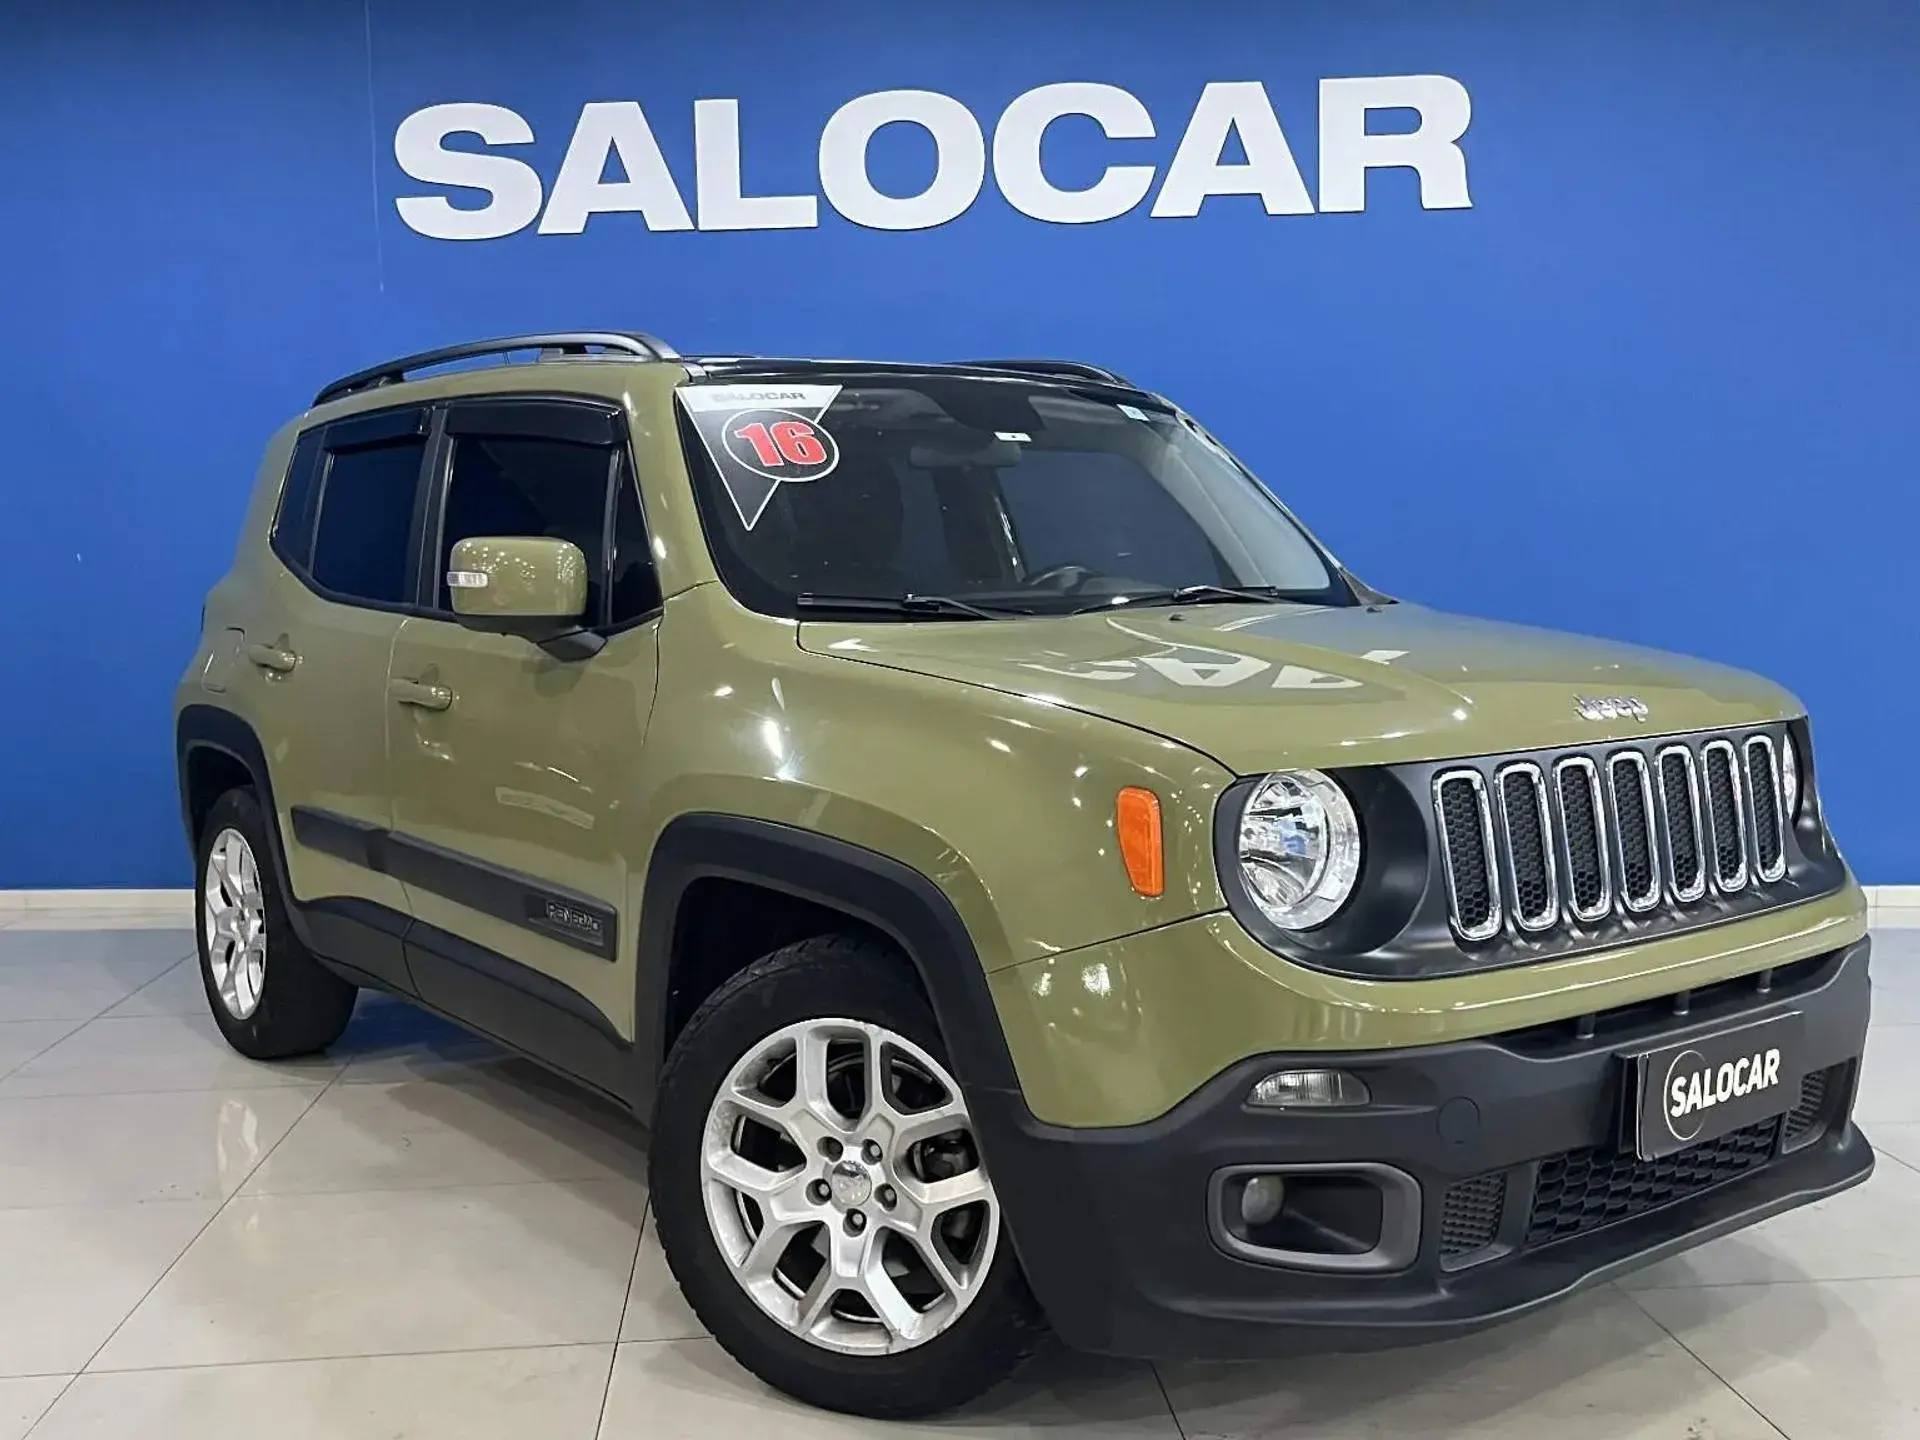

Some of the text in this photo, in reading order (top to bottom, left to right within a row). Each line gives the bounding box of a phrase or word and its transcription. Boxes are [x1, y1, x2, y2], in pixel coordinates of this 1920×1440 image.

[394, 75, 1473, 240] SALOCAR
[734, 421, 828, 467] 16
[1670, 1048, 1781, 1118] SALOCAR
